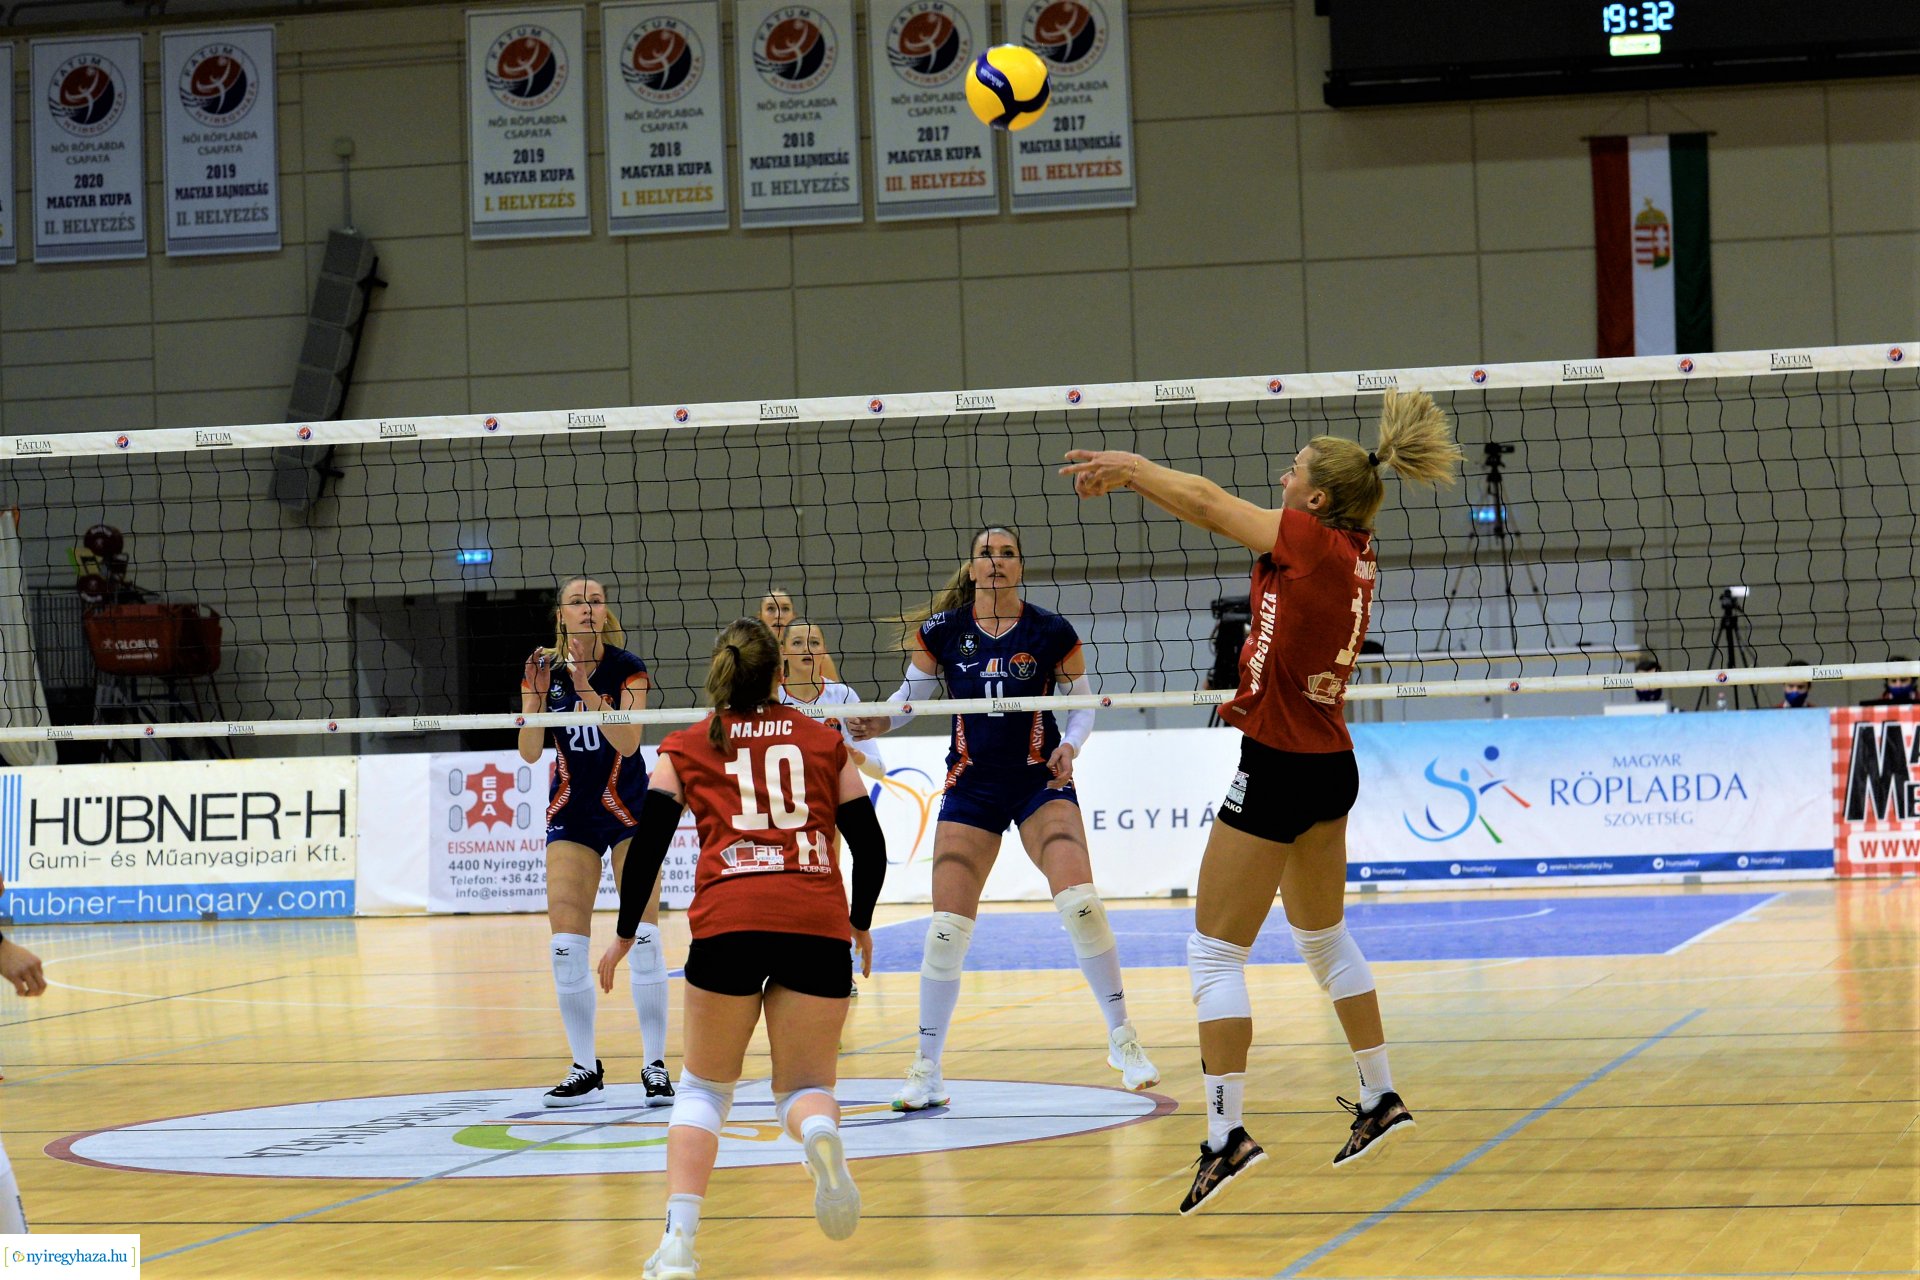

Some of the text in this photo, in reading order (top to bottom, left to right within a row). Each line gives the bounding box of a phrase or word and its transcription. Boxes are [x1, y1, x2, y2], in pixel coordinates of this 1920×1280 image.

[1603, 1, 1674, 33] 19:32
[914, 92, 964, 104] RÖPLABD
[1054, 116, 1086, 132] 2017
[783, 132, 815, 148] 2018
[918, 126, 950, 142] 2017
[650, 142, 682, 158] 2018
[888, 146, 981, 164] MAGYAR KUPA
[1020, 139, 1061, 154] MAGYAR
[513, 149, 544, 164] 2019
[750, 148, 849, 170] MAGYAR BAJNOKSÁG
[207, 164, 236, 179] 2019
[484, 169, 575, 185] MAGYAR KUPA
[621, 162, 712, 180] MAGYAR KUPA
[1047, 156, 1123, 180] HELYEZÉS
[75, 174, 103, 188] 2020
[771, 172, 850, 195] HELYEZÉS
[911, 168, 986, 190] HELYEZÉS
[175, 180, 269, 200] MAGYAR BAJNOKSÁG
[636, 183, 714, 206] HELYEZÉS
[47, 193, 131, 209] MAGYAR KUPA
[499, 189, 576, 211] HELYEZÉS
[63, 212, 135, 233] HELYEZÉS
[195, 203, 269, 225] HELYEZÉS
[565, 724, 601, 752] 20
[1613, 753, 1681, 769] MAGYAR
[481, 776, 497, 816] EGA
[724, 744, 809, 830] 10
[1550, 771, 1748, 806] RÖPLABDA
[29, 788, 347, 846] HÜBNER-H
[1604, 810, 1694, 828] SZÖVETSÉG
[448, 840, 515, 855] EISSMANN
[29, 844, 347, 870] Gumi- és Műanyagipari Kft.
[449, 859, 480, 871] 4400
[484, 858, 547, 872] Nyiregyh
[450, 875, 497, 885] Telefon:
[501, 873, 521, 884] +36
[524, 873, 538, 883] 42
